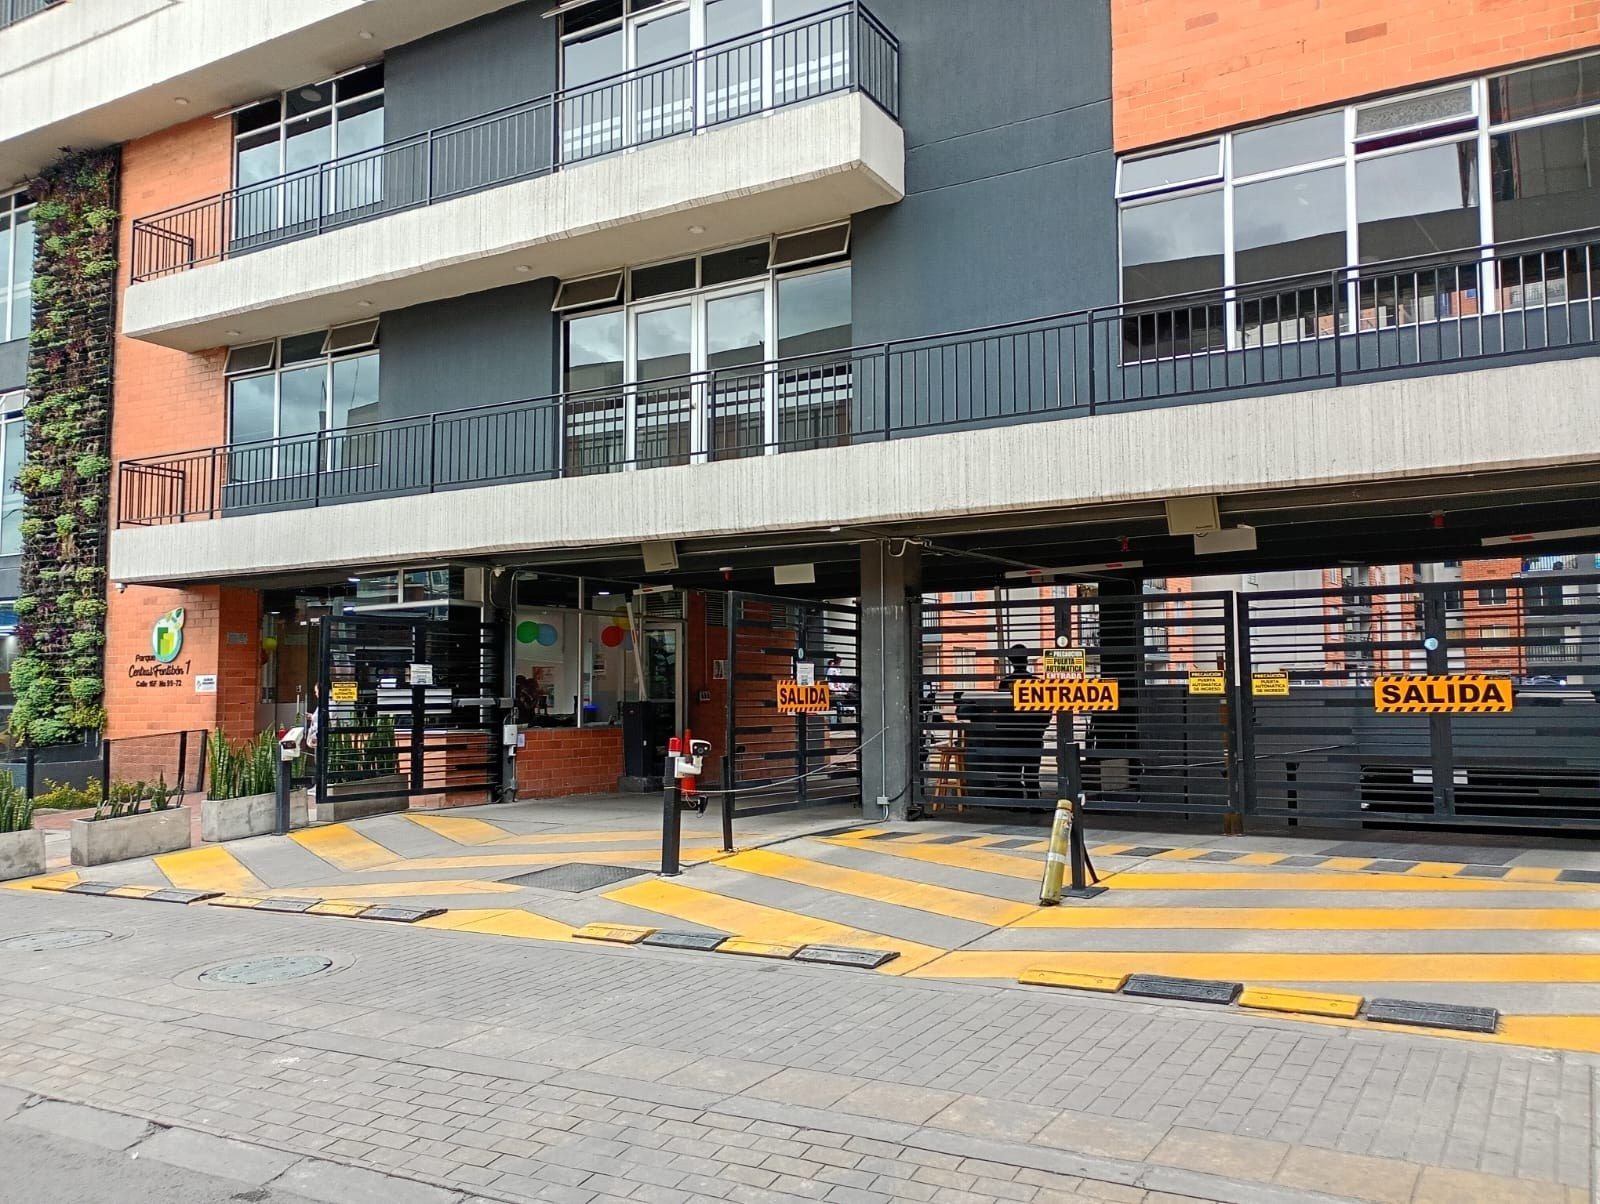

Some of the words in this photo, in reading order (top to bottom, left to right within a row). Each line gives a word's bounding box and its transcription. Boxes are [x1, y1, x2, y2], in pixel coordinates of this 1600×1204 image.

[135, 654, 156, 662] Parque
[128, 664, 154, 678] Central
[1046, 672, 1083, 680] ENTRADA
[136, 680, 148, 688] Calle
[780, 687, 827, 705] SALIDA
[1018, 685, 1114, 704] ENTRADA
[1381, 683, 1505, 704] SALIDA
